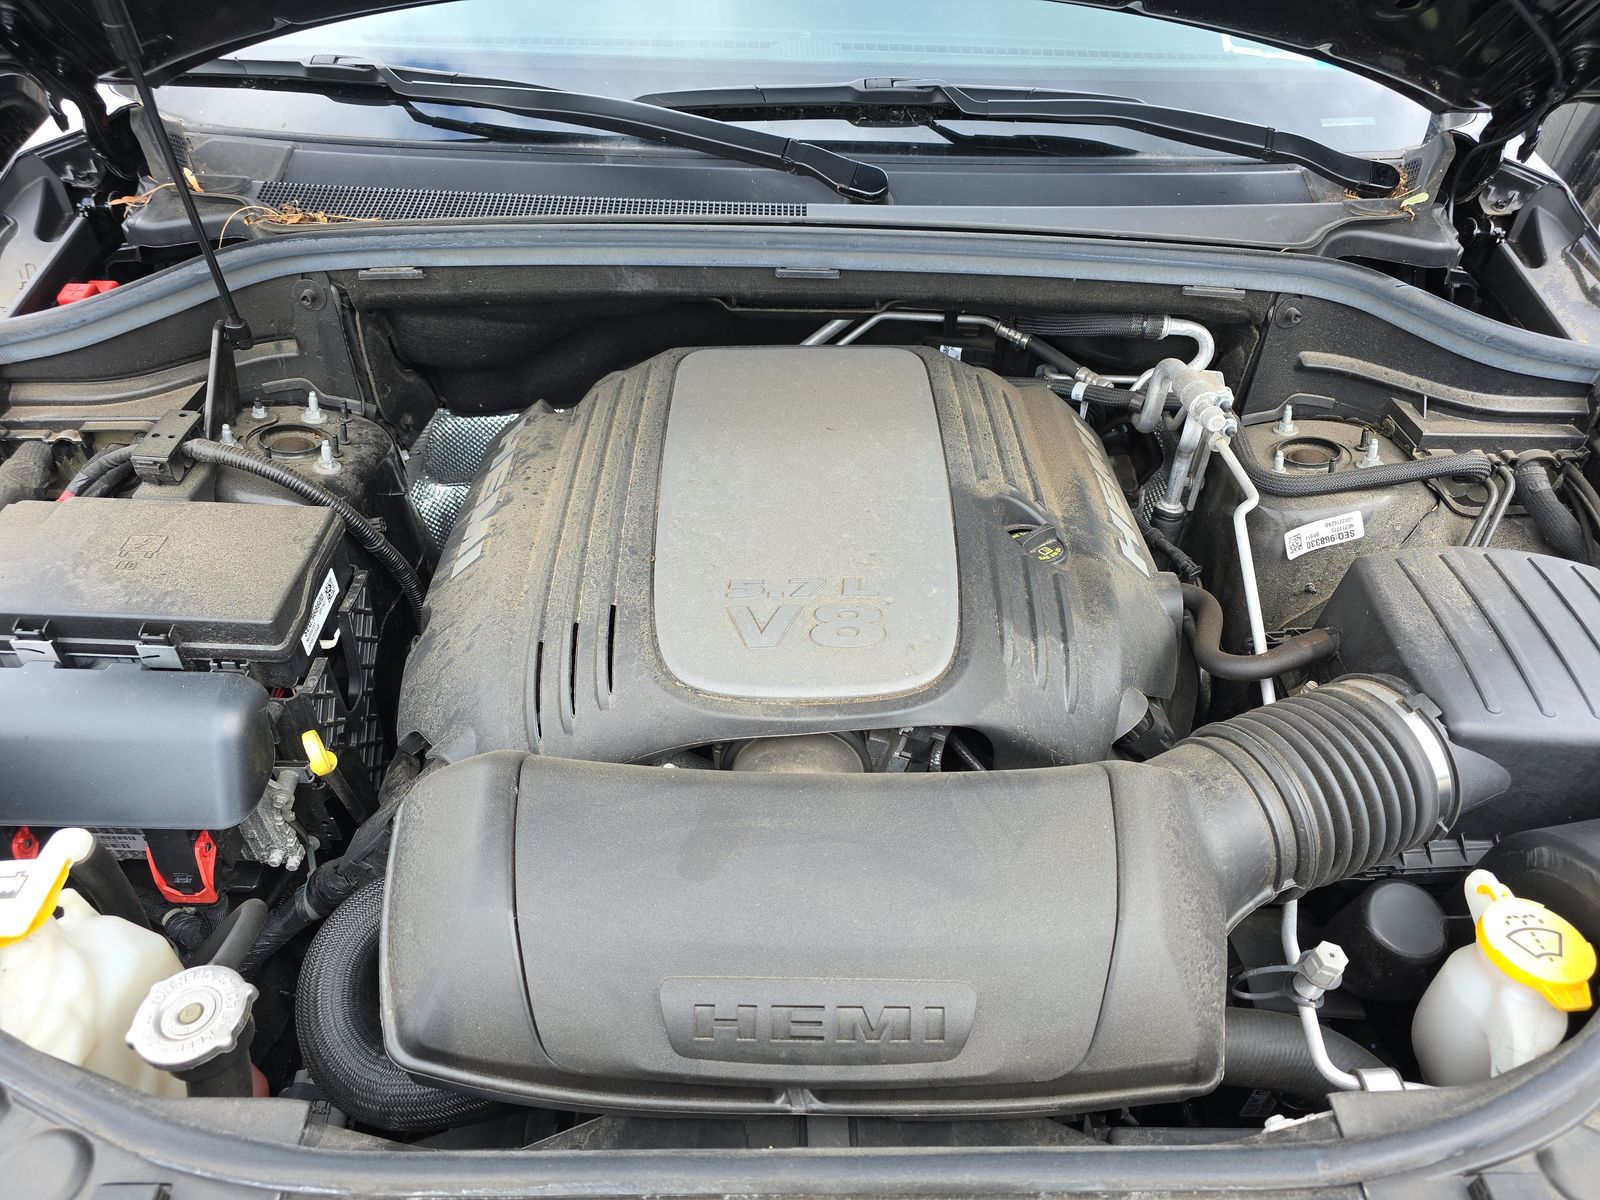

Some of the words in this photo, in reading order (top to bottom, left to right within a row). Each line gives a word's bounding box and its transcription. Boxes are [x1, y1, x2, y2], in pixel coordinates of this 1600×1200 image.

[451, 416, 528, 579] HEMI
[1071, 415, 1150, 578] HEMI
[726, 604, 887, 648] V8
[693, 1003, 946, 1043] HEMI
